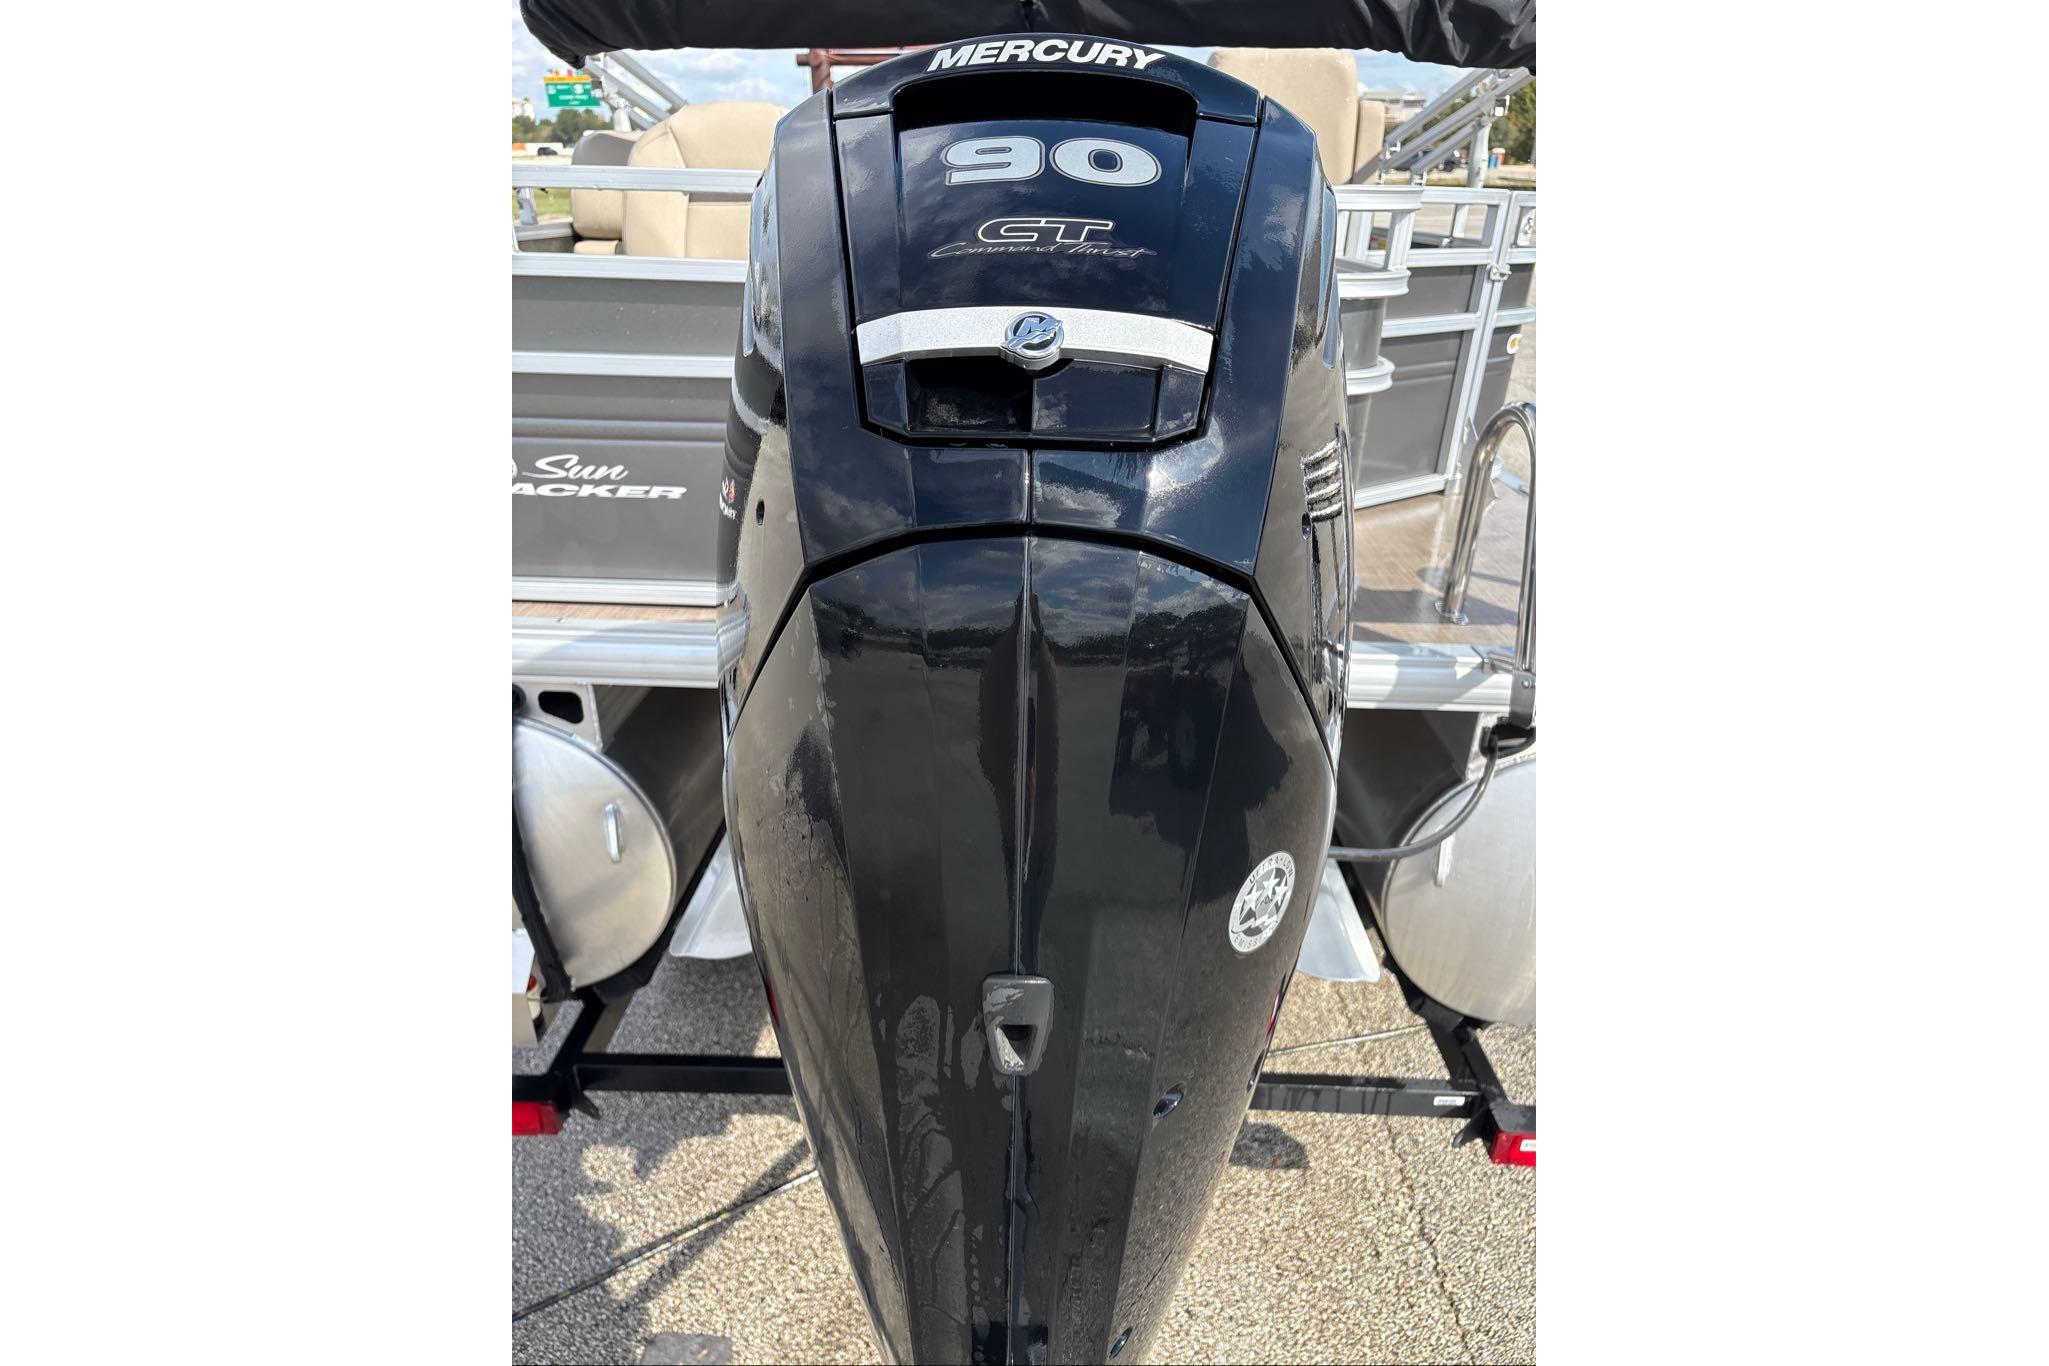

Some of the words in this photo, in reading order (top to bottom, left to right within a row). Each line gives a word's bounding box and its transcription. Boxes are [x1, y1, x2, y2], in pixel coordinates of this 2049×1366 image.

[926, 39, 1167, 71] MERCURY
[940, 135, 1162, 187] 90
[977, 217, 1114, 243] CT
[929, 241, 1061, 258] Command
[1066, 241, 1158, 258] Thrust
[521, 454, 629, 480] Sun
